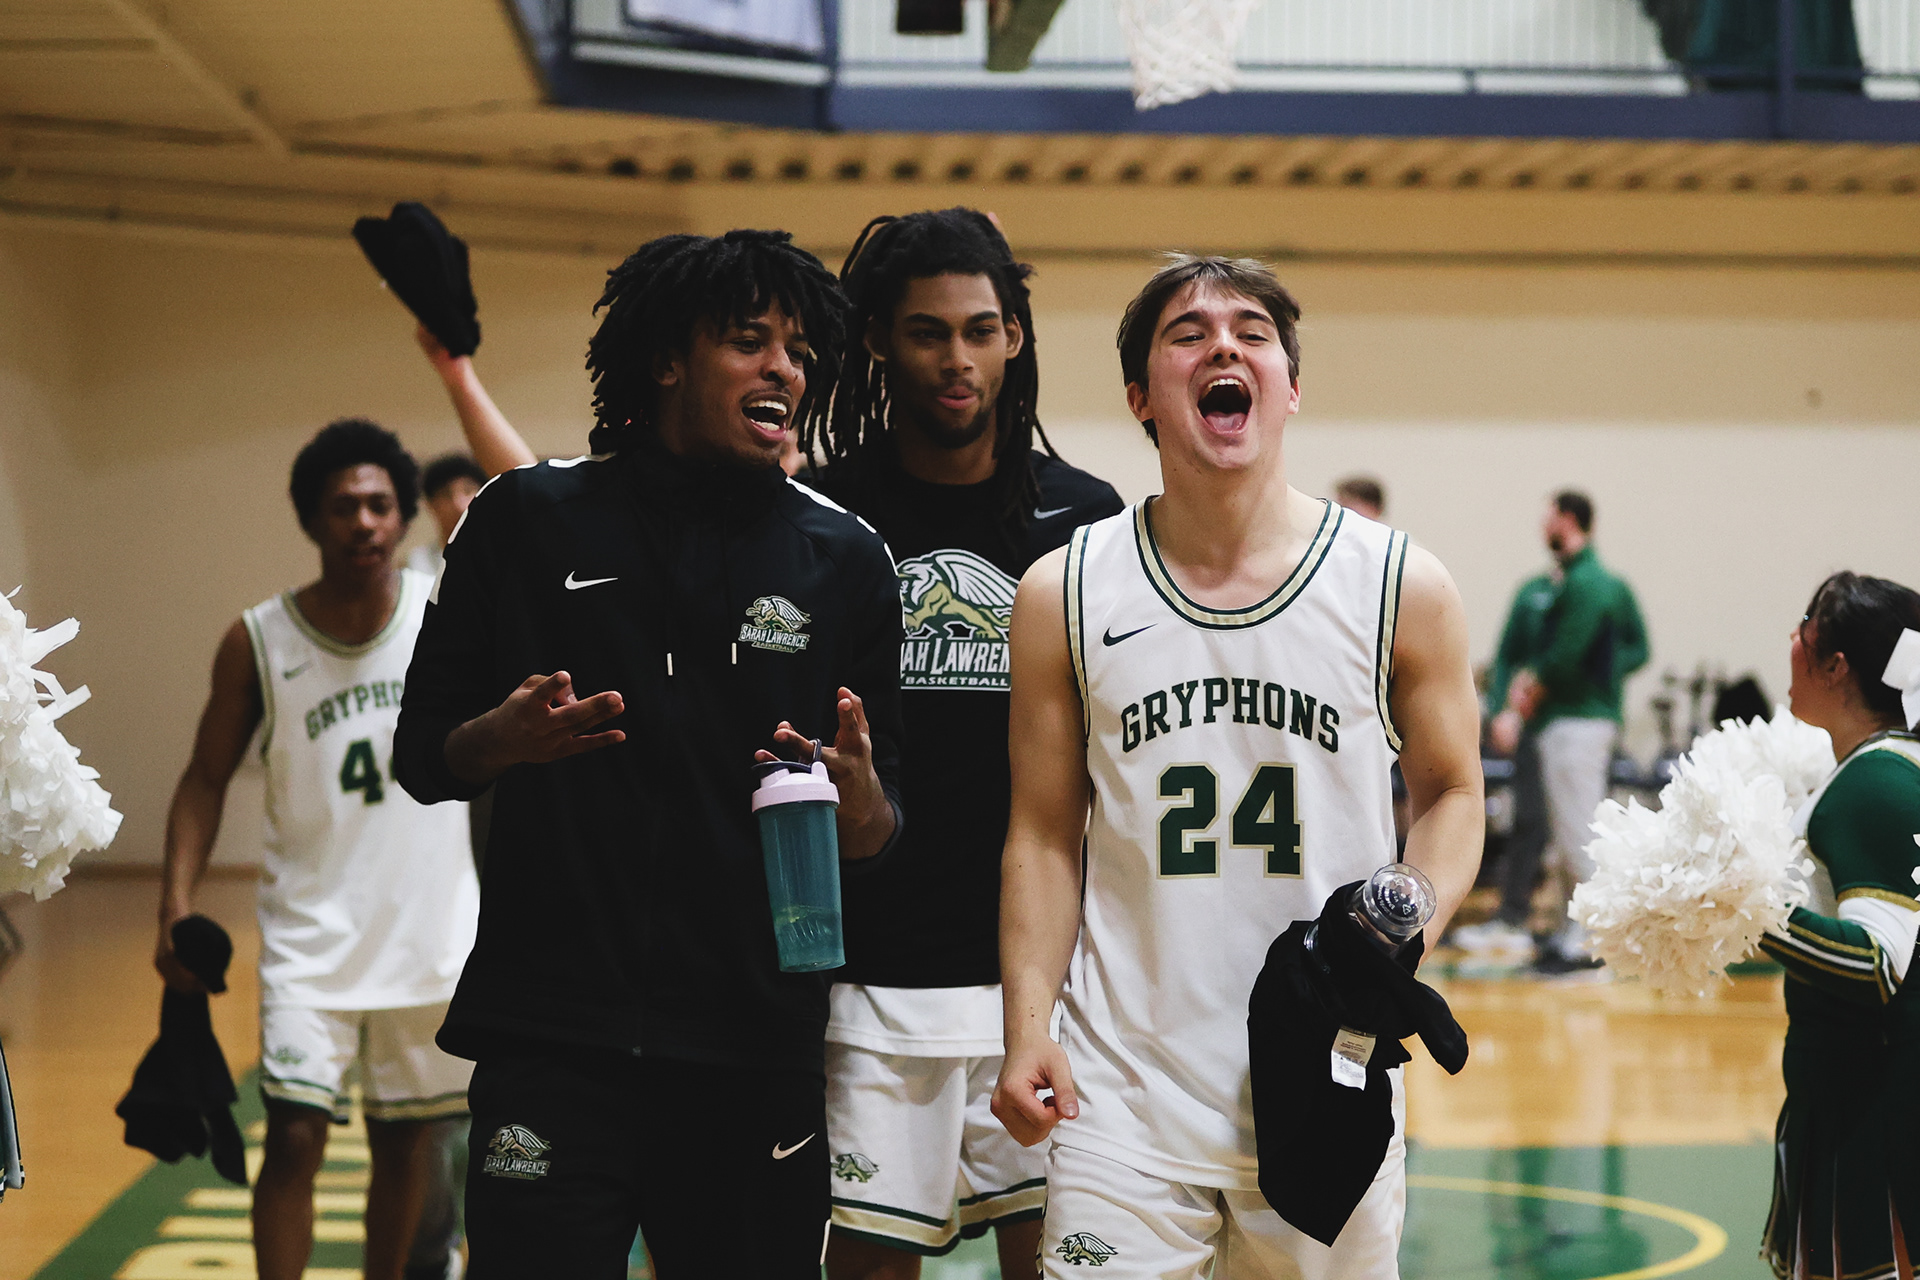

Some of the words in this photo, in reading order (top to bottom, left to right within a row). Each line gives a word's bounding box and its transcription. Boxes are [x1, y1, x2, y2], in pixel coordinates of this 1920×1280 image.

[741, 625, 768, 642] SARAH
[766, 629, 807, 648] LAWRENCE
[904, 676, 1009, 687] BASKETBALL
[1120, 677, 1340, 754] GRYPHONS
[1156, 761, 1305, 880] 24
[504, 1157, 547, 1173] LAWRENCE
